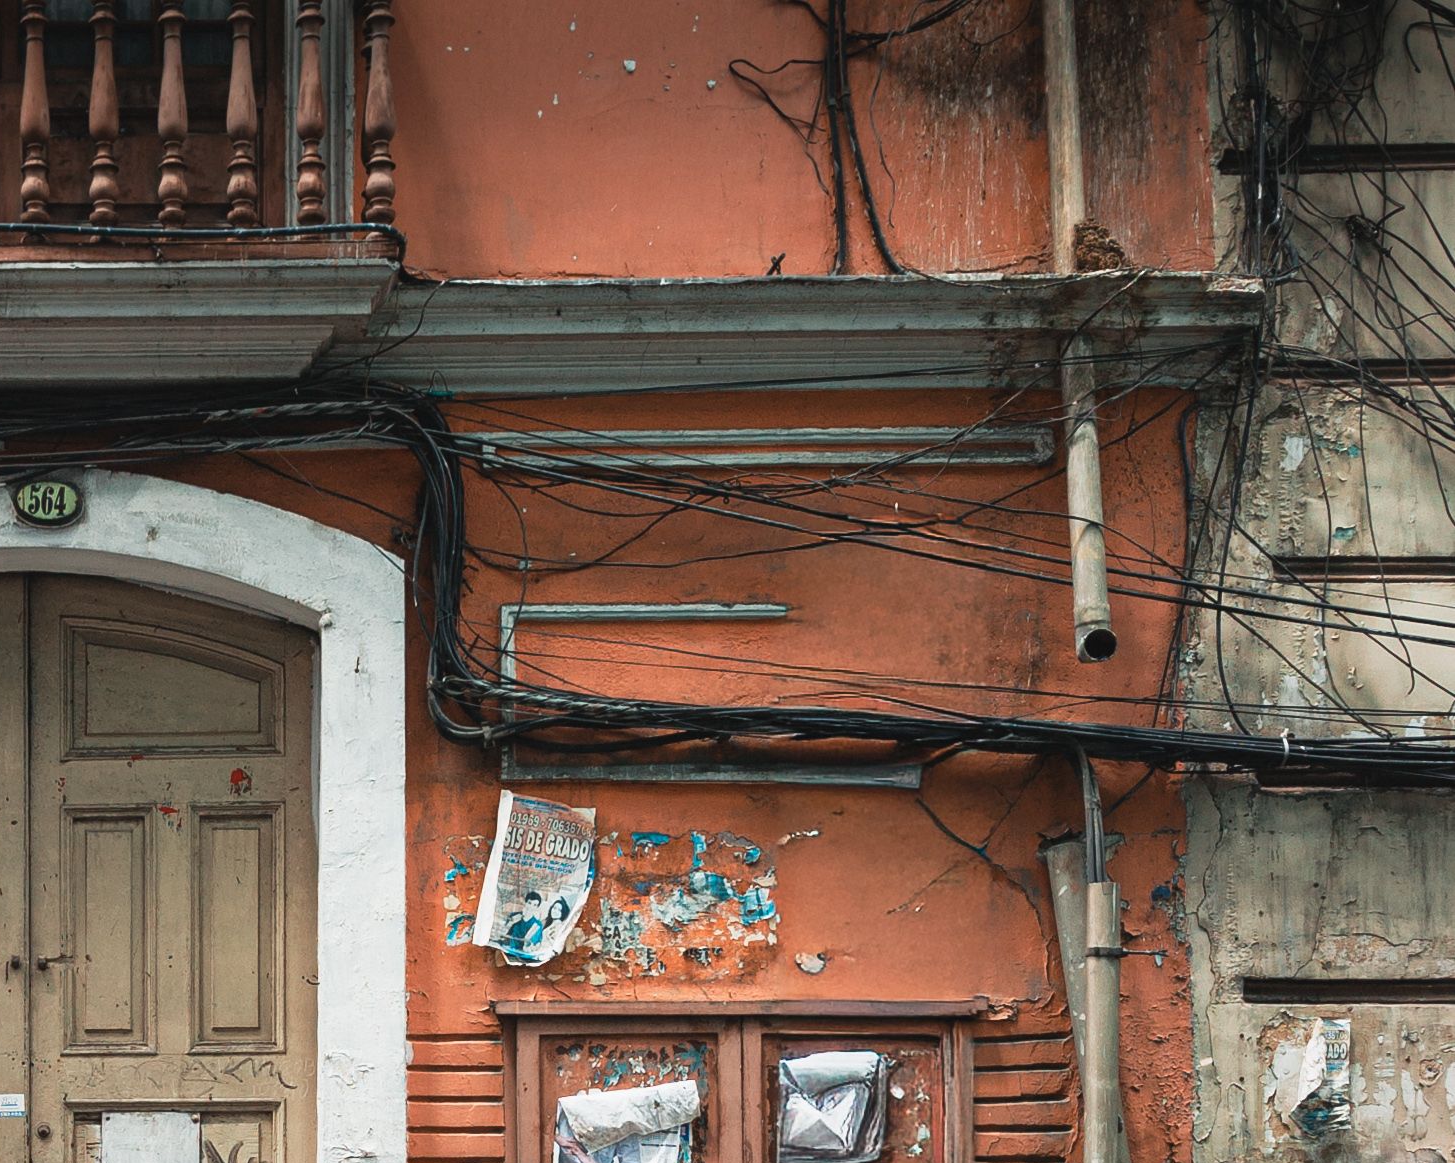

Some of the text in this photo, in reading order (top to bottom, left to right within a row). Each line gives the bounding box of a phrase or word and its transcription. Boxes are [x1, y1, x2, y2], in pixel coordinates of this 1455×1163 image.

[28, 484, 66, 516] 564
[525, 829, 544, 853] DE
[546, 832, 591, 862] GRADO
